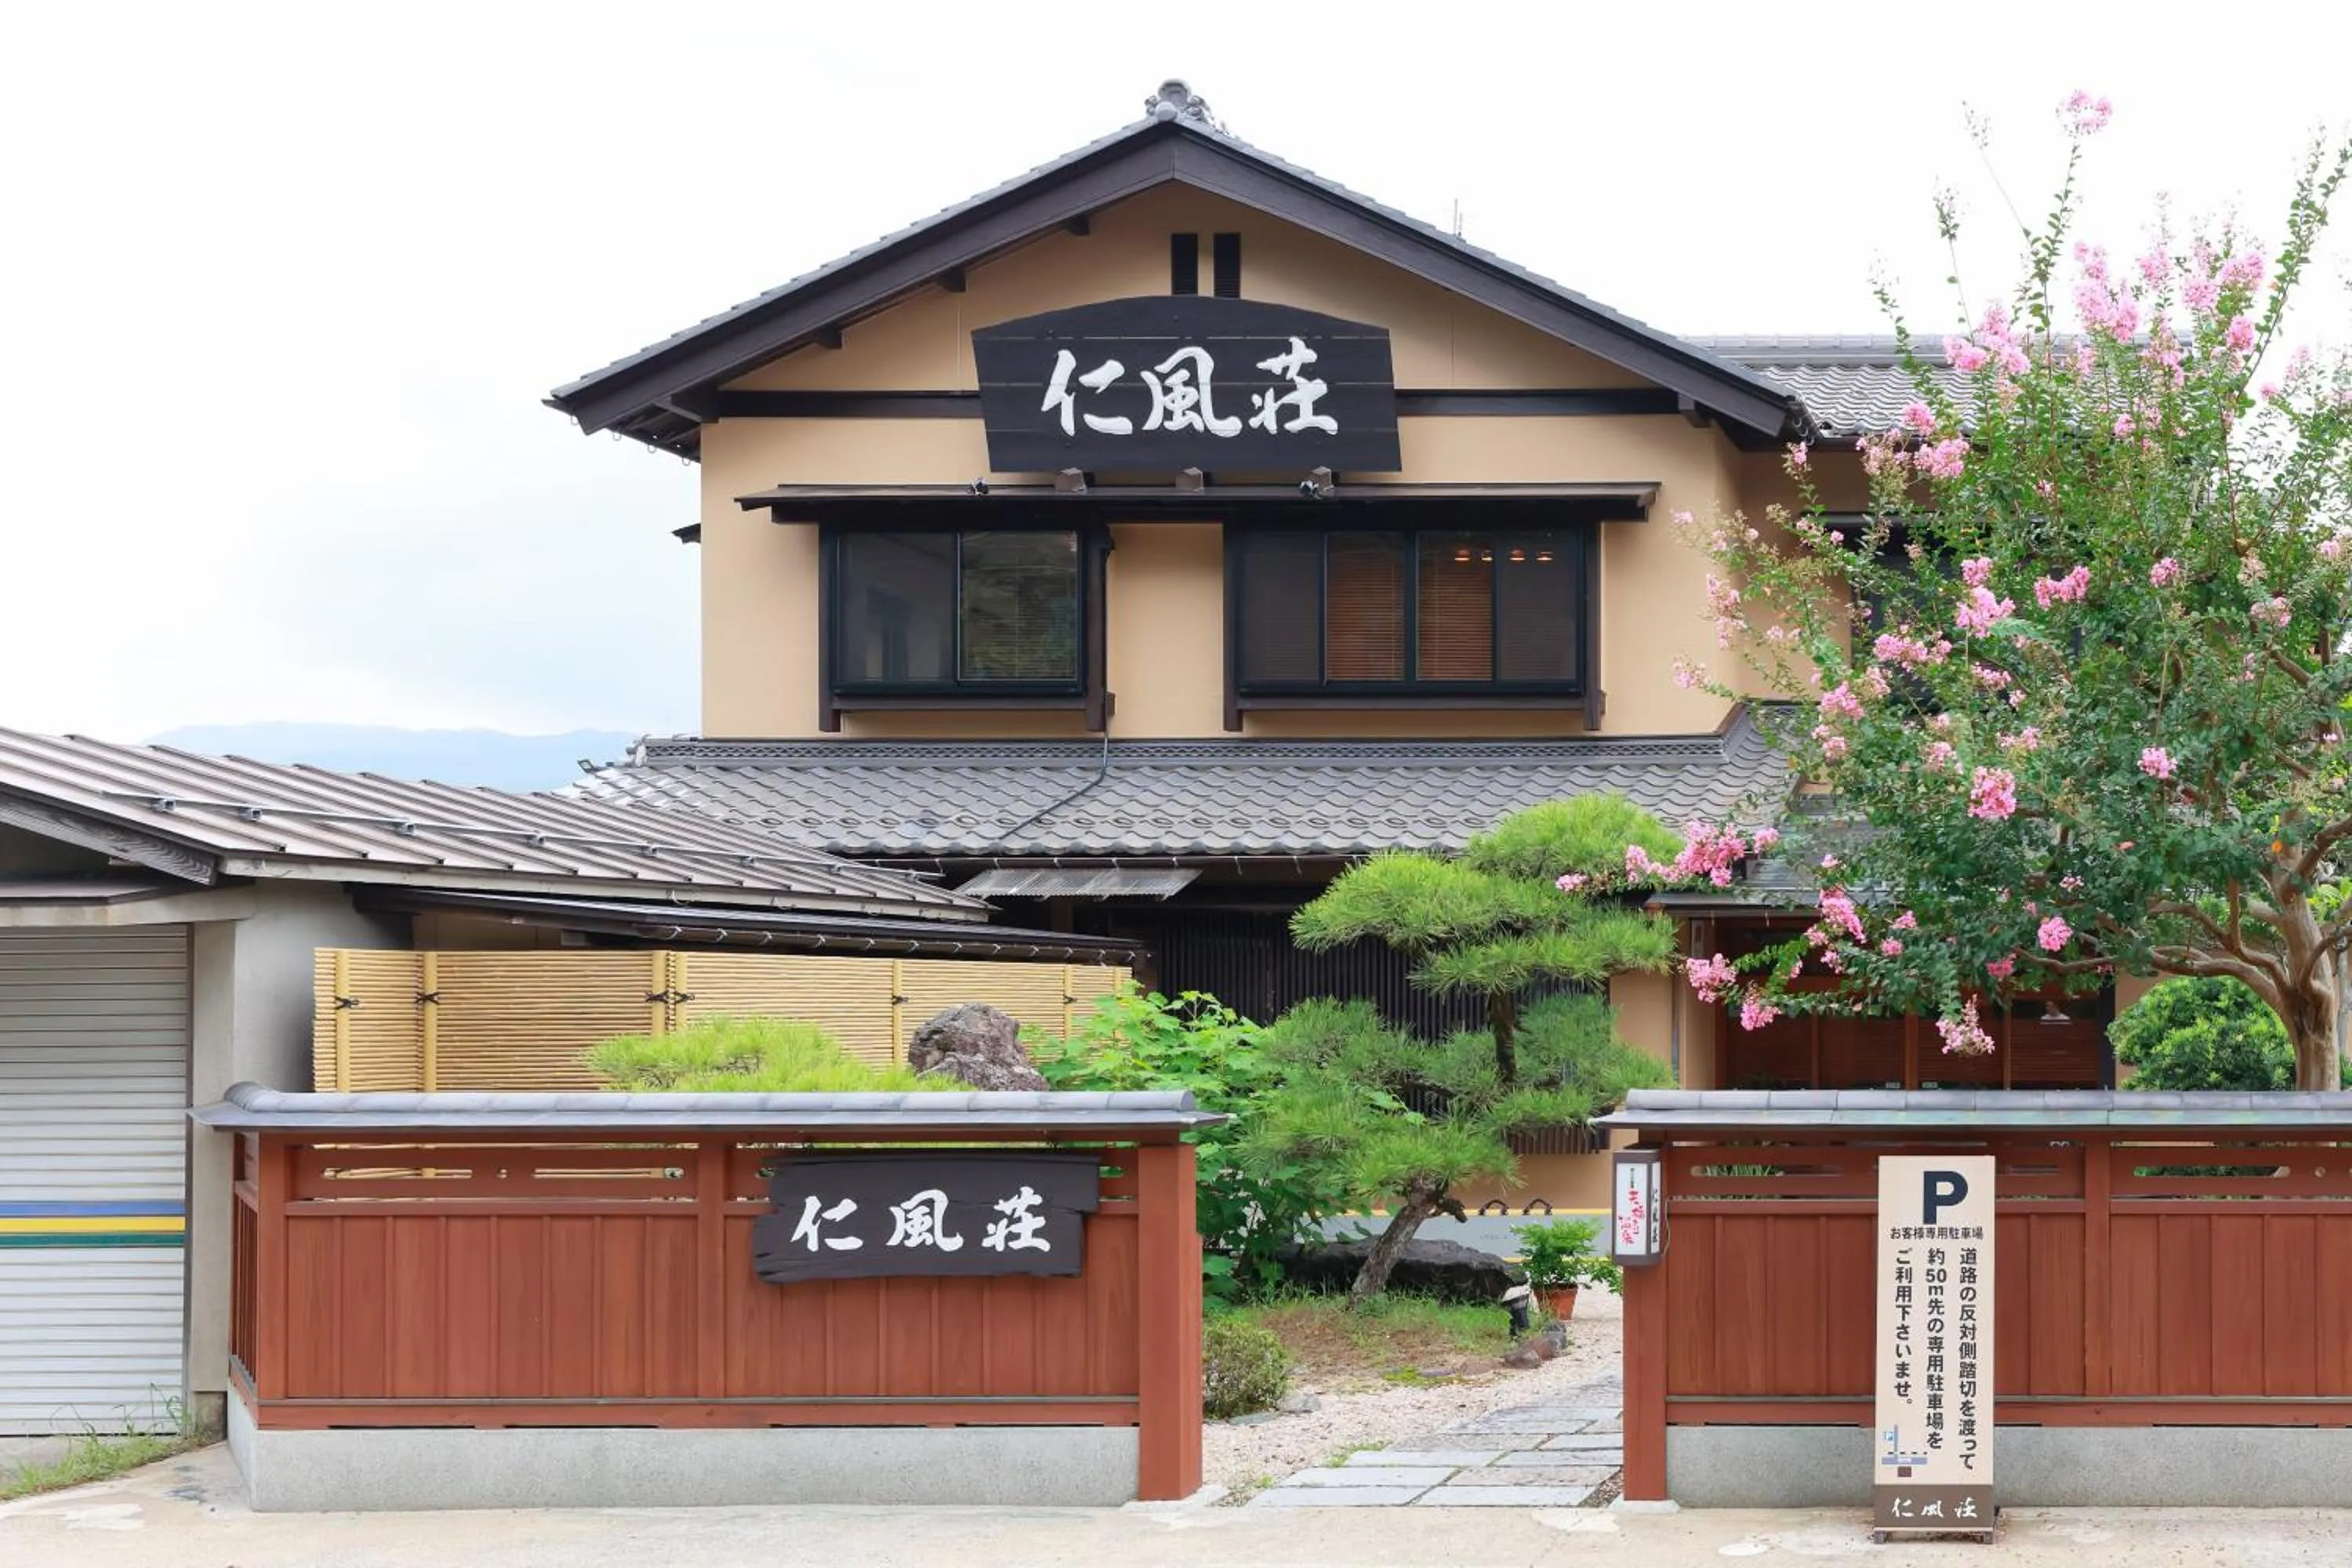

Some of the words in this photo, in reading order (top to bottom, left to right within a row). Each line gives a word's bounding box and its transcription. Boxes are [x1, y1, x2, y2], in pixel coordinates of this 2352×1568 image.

[1041, 336, 1338, 437] 仁風荘
[790, 1186, 1051, 1252] 仁風荘
[1890, 1226, 1984, 1240] お客様専用駐車場
[1923, 1171, 1969, 1225] P
[1894, 1247, 1913, 1404] ご利用下さいませ。
[1925, 1247, 1947, 1450] 約50m先の専用駐車場を
[1958, 1247, 1977, 1470] 道路の反対側踏切を渡って
[1892, 1497, 1978, 1518] 仁風荘
